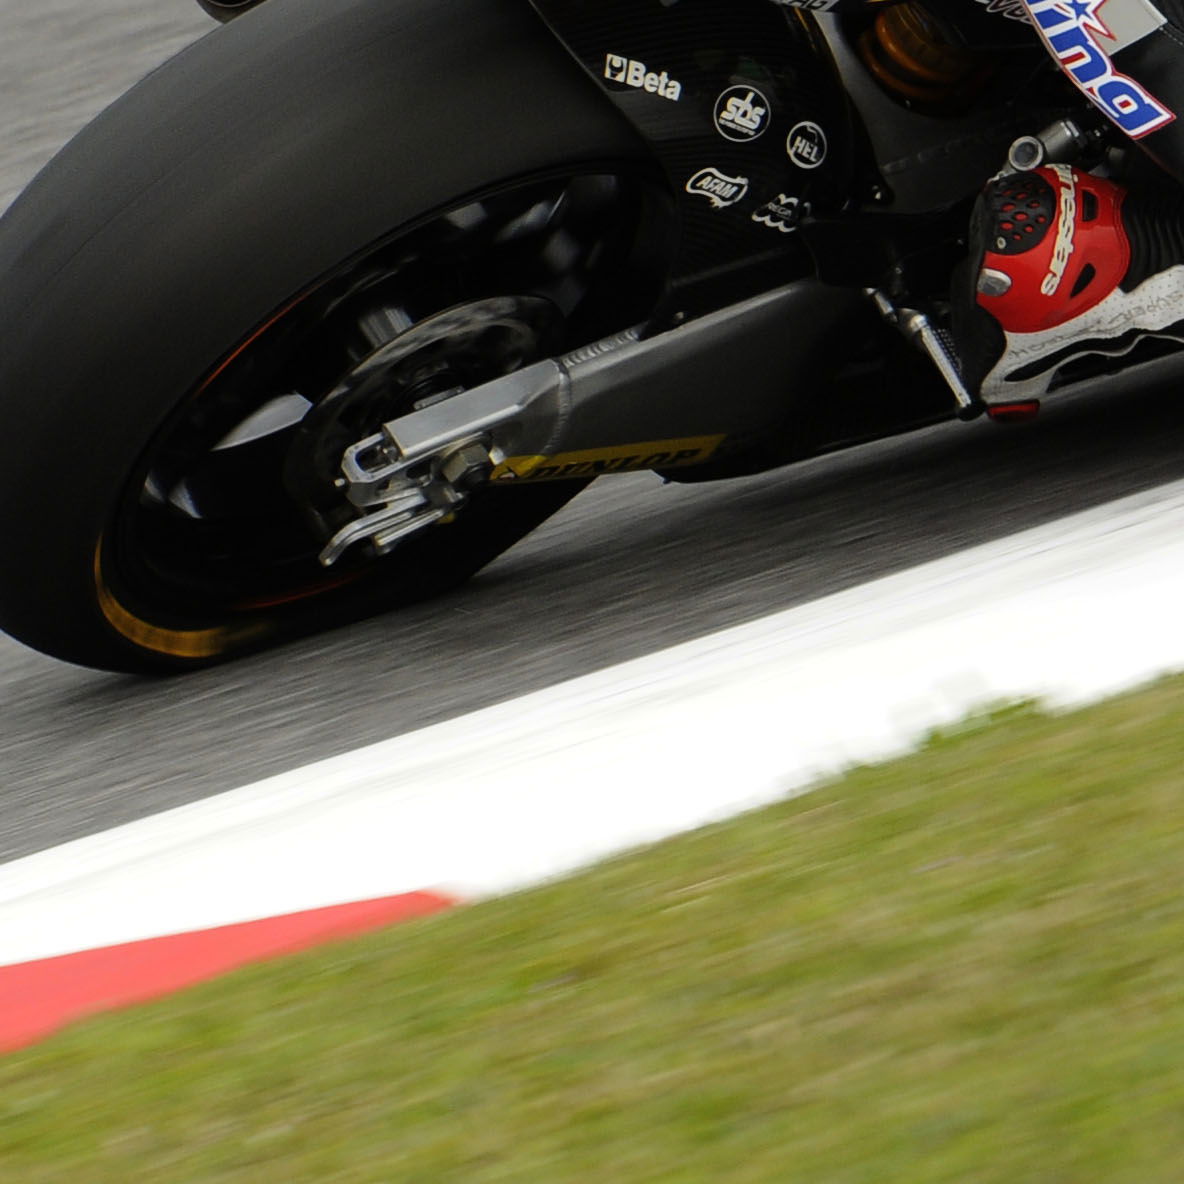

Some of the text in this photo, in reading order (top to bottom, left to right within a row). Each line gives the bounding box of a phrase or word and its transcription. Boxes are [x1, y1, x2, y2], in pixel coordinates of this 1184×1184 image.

[626, 59, 681, 102] Beta
[719, 92, 765, 131] sbs
[792, 137, 819, 163] HEL
[697, 176, 739, 199] AFAM
